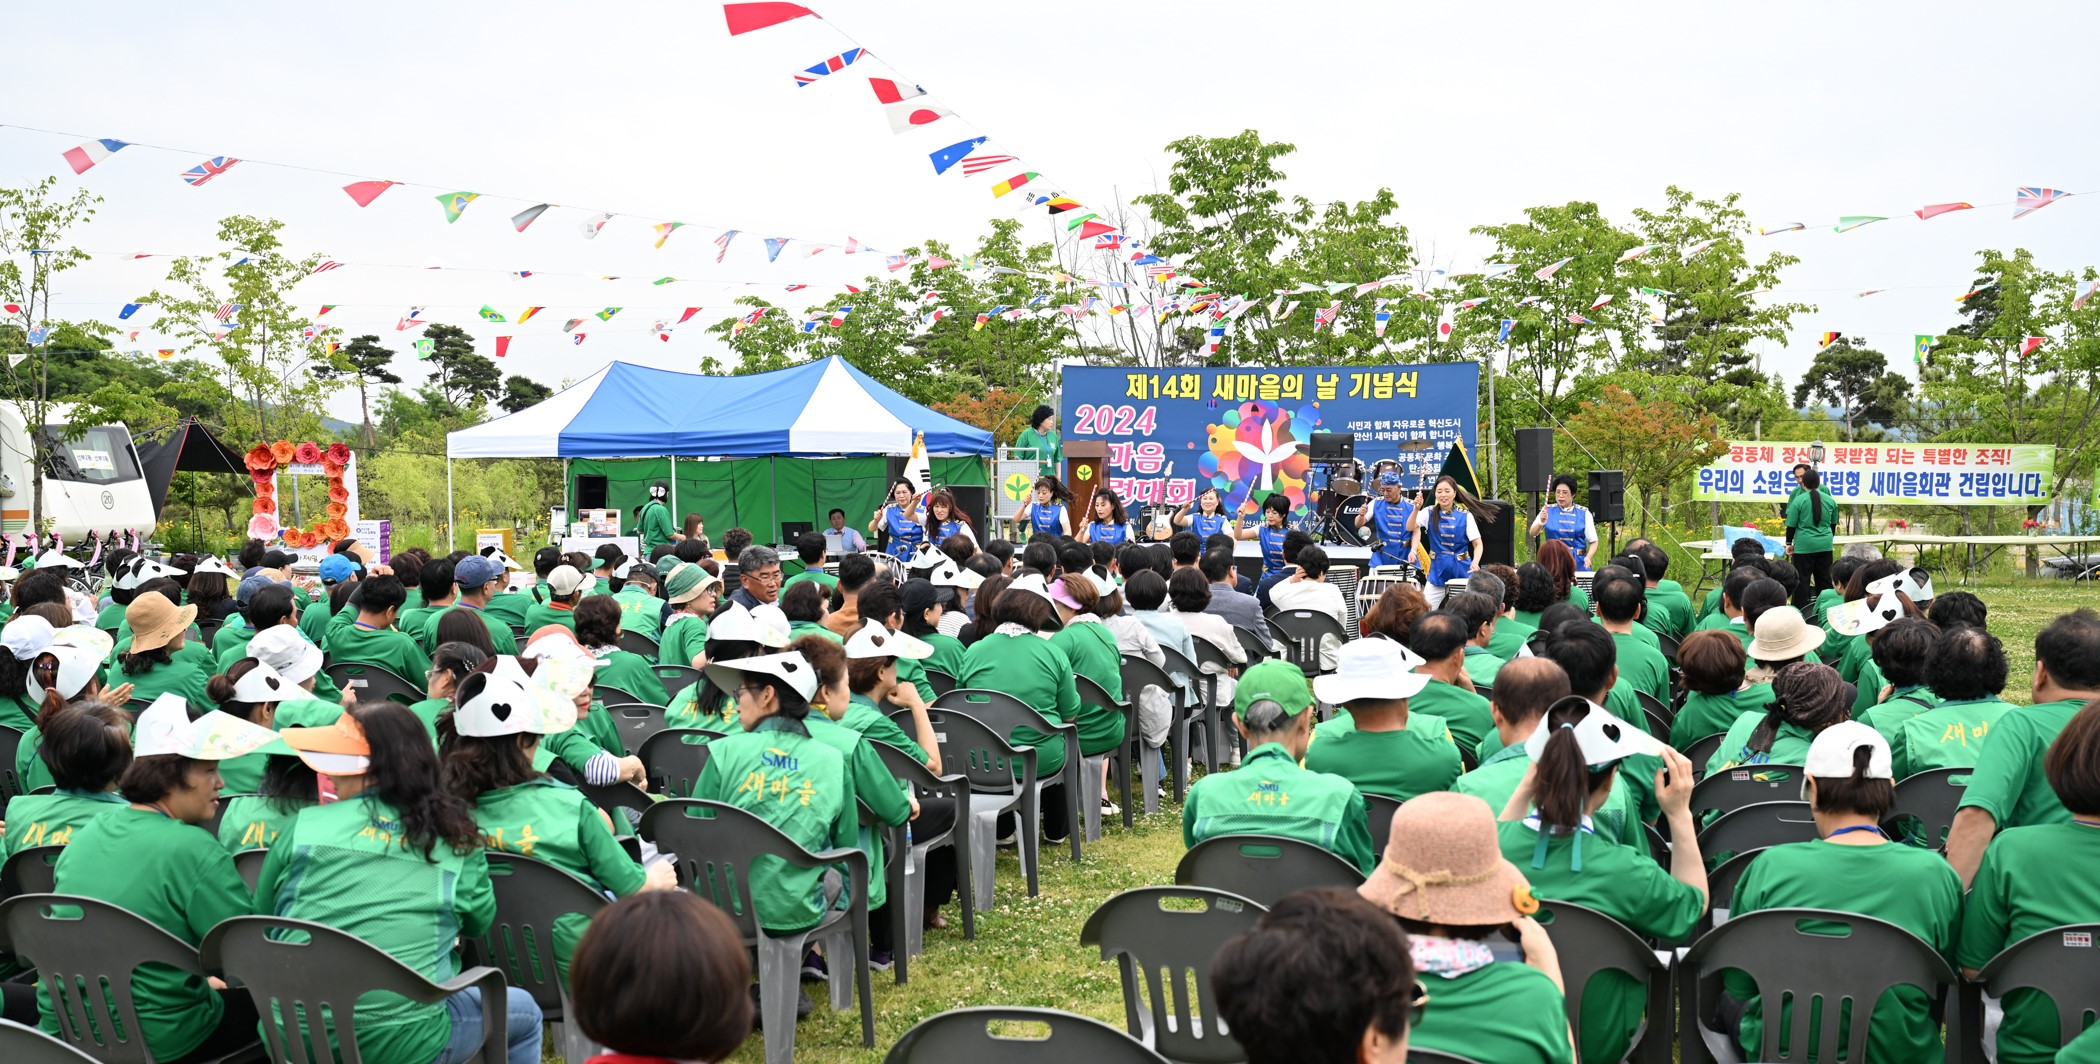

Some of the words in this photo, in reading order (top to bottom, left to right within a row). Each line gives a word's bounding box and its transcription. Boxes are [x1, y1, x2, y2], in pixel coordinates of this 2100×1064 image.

[1126, 373, 1201, 400] 제14회
[1212, 373, 1305, 400] 새마을의
[1315, 373, 1340, 400] 날
[1348, 371, 1419, 400] 기념식
[1074, 404, 1157, 436] 2024
[1347, 421, 1372, 431] 시민과
[1374, 420, 1391, 430] 함께
[1393, 419, 1426, 429] 자유로운
[1428, 418, 1461, 428] 혁신도시
[1353, 432, 1373, 441] 안산!
[1375, 431, 1408, 441] 새마을이
[1410, 430, 1427, 440] 함께
[1108, 441, 1166, 474] 마음
[1730, 445, 1774, 463] 공동체
[1833, 447, 1878, 464] 뒷받침
[1886, 447, 1915, 465] 되는
[1923, 448, 1968, 466] 특별한
[1975, 448, 2012, 466] 조직!
[1110, 477, 1197, 508] 련대회
[1698, 468, 1745, 495] 우리의
[1752, 470, 1798, 496] 소원은
[1869, 471, 1952, 498] 새마을회관
[1958, 472, 2047, 498] 건립입니다.
[103, 494, 113, 505] 20
[1939, 719, 1989, 747] 새마
[761, 750, 799, 771] SMU
[737, 771, 817, 807] 새마을
[1258, 782, 1279, 792] SMU
[21, 821, 73, 847] 새마
[487, 823, 540, 857] 마을
